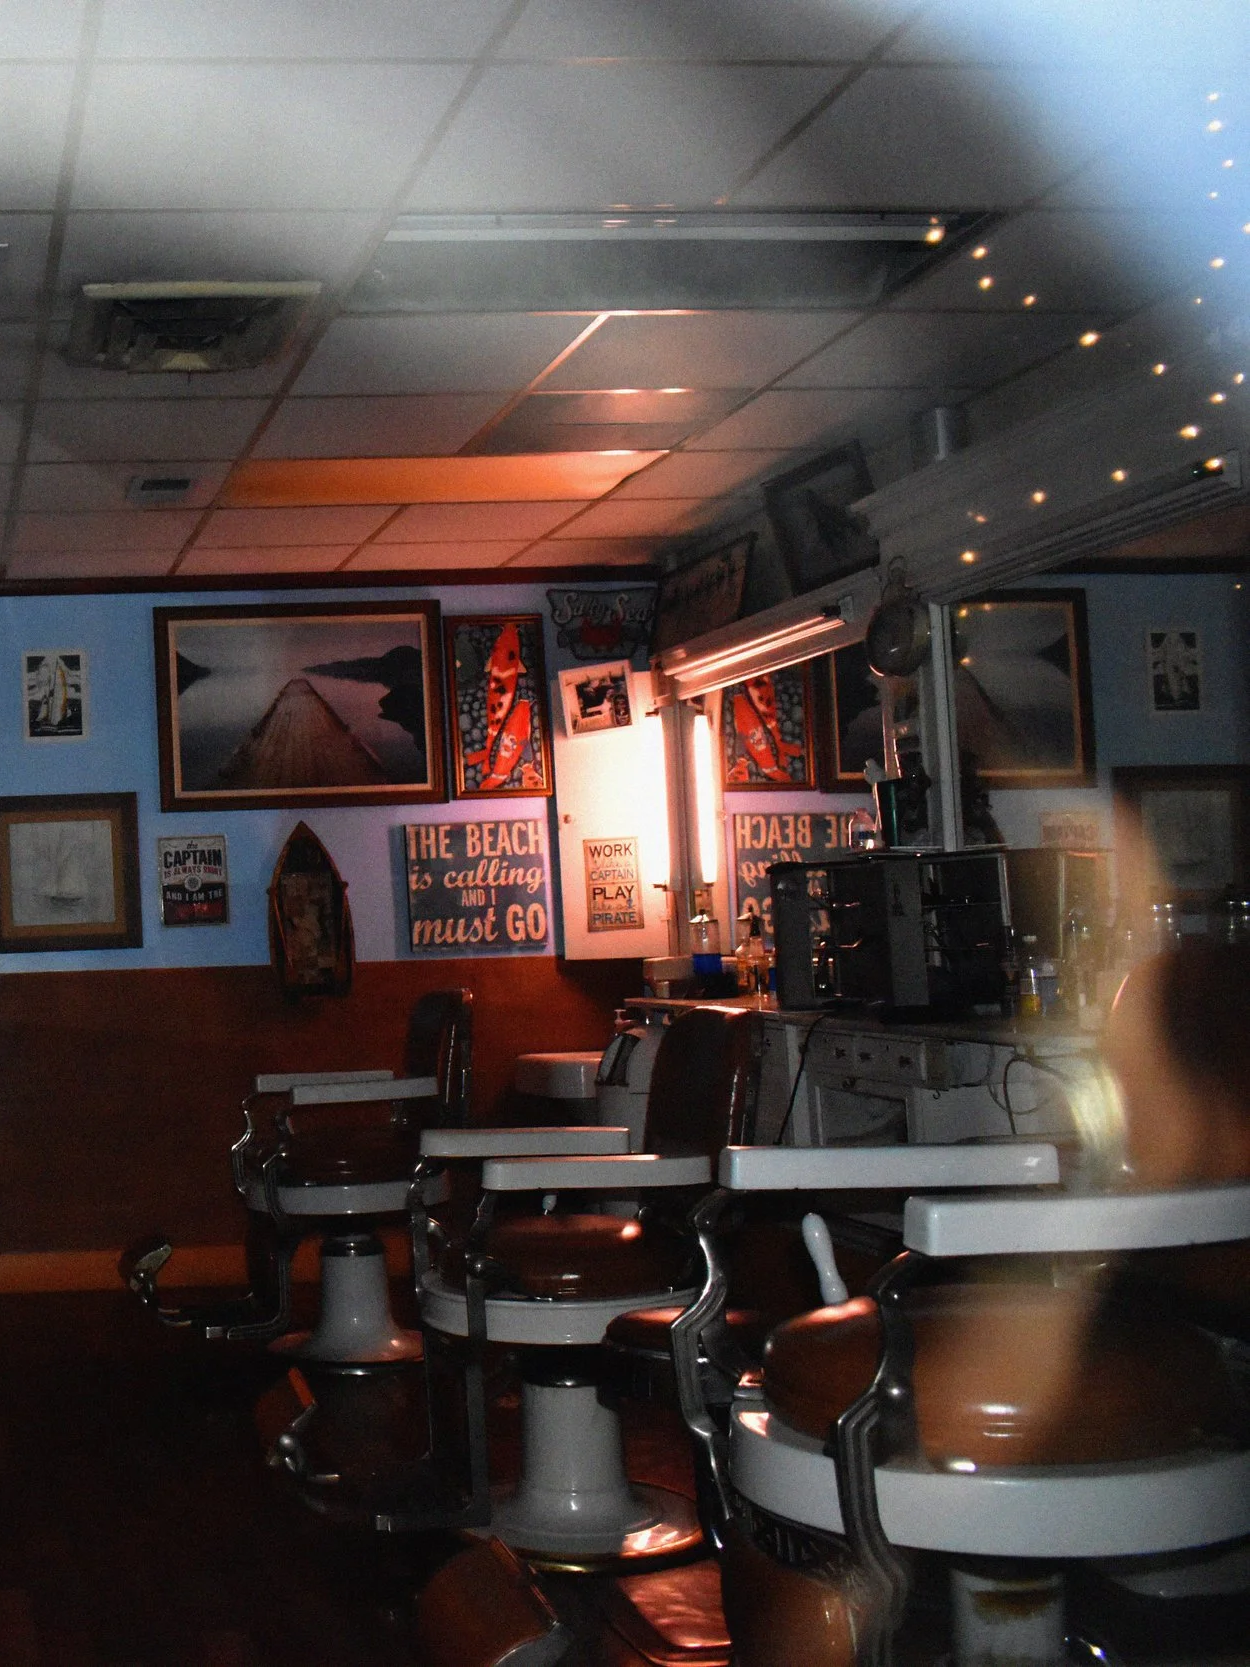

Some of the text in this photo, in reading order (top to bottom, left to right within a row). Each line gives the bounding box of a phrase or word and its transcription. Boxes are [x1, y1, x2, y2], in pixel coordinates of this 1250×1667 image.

[407, 821, 544, 861] THE BEACH
[589, 843, 634, 858] WORK
[164, 848, 222, 869] CAPTAIN
[163, 870, 172, 879] IS
[409, 858, 543, 894] is calling
[590, 868, 635, 881] CAPTAIN
[165, 890, 183, 901] AND
[192, 893, 205, 901] AM
[209, 889, 224, 900] THE
[461, 888, 496, 907] AND I
[593, 885, 635, 899] PLAY
[413, 902, 547, 945] must GO
[592, 911, 637, 925] PIRATE
